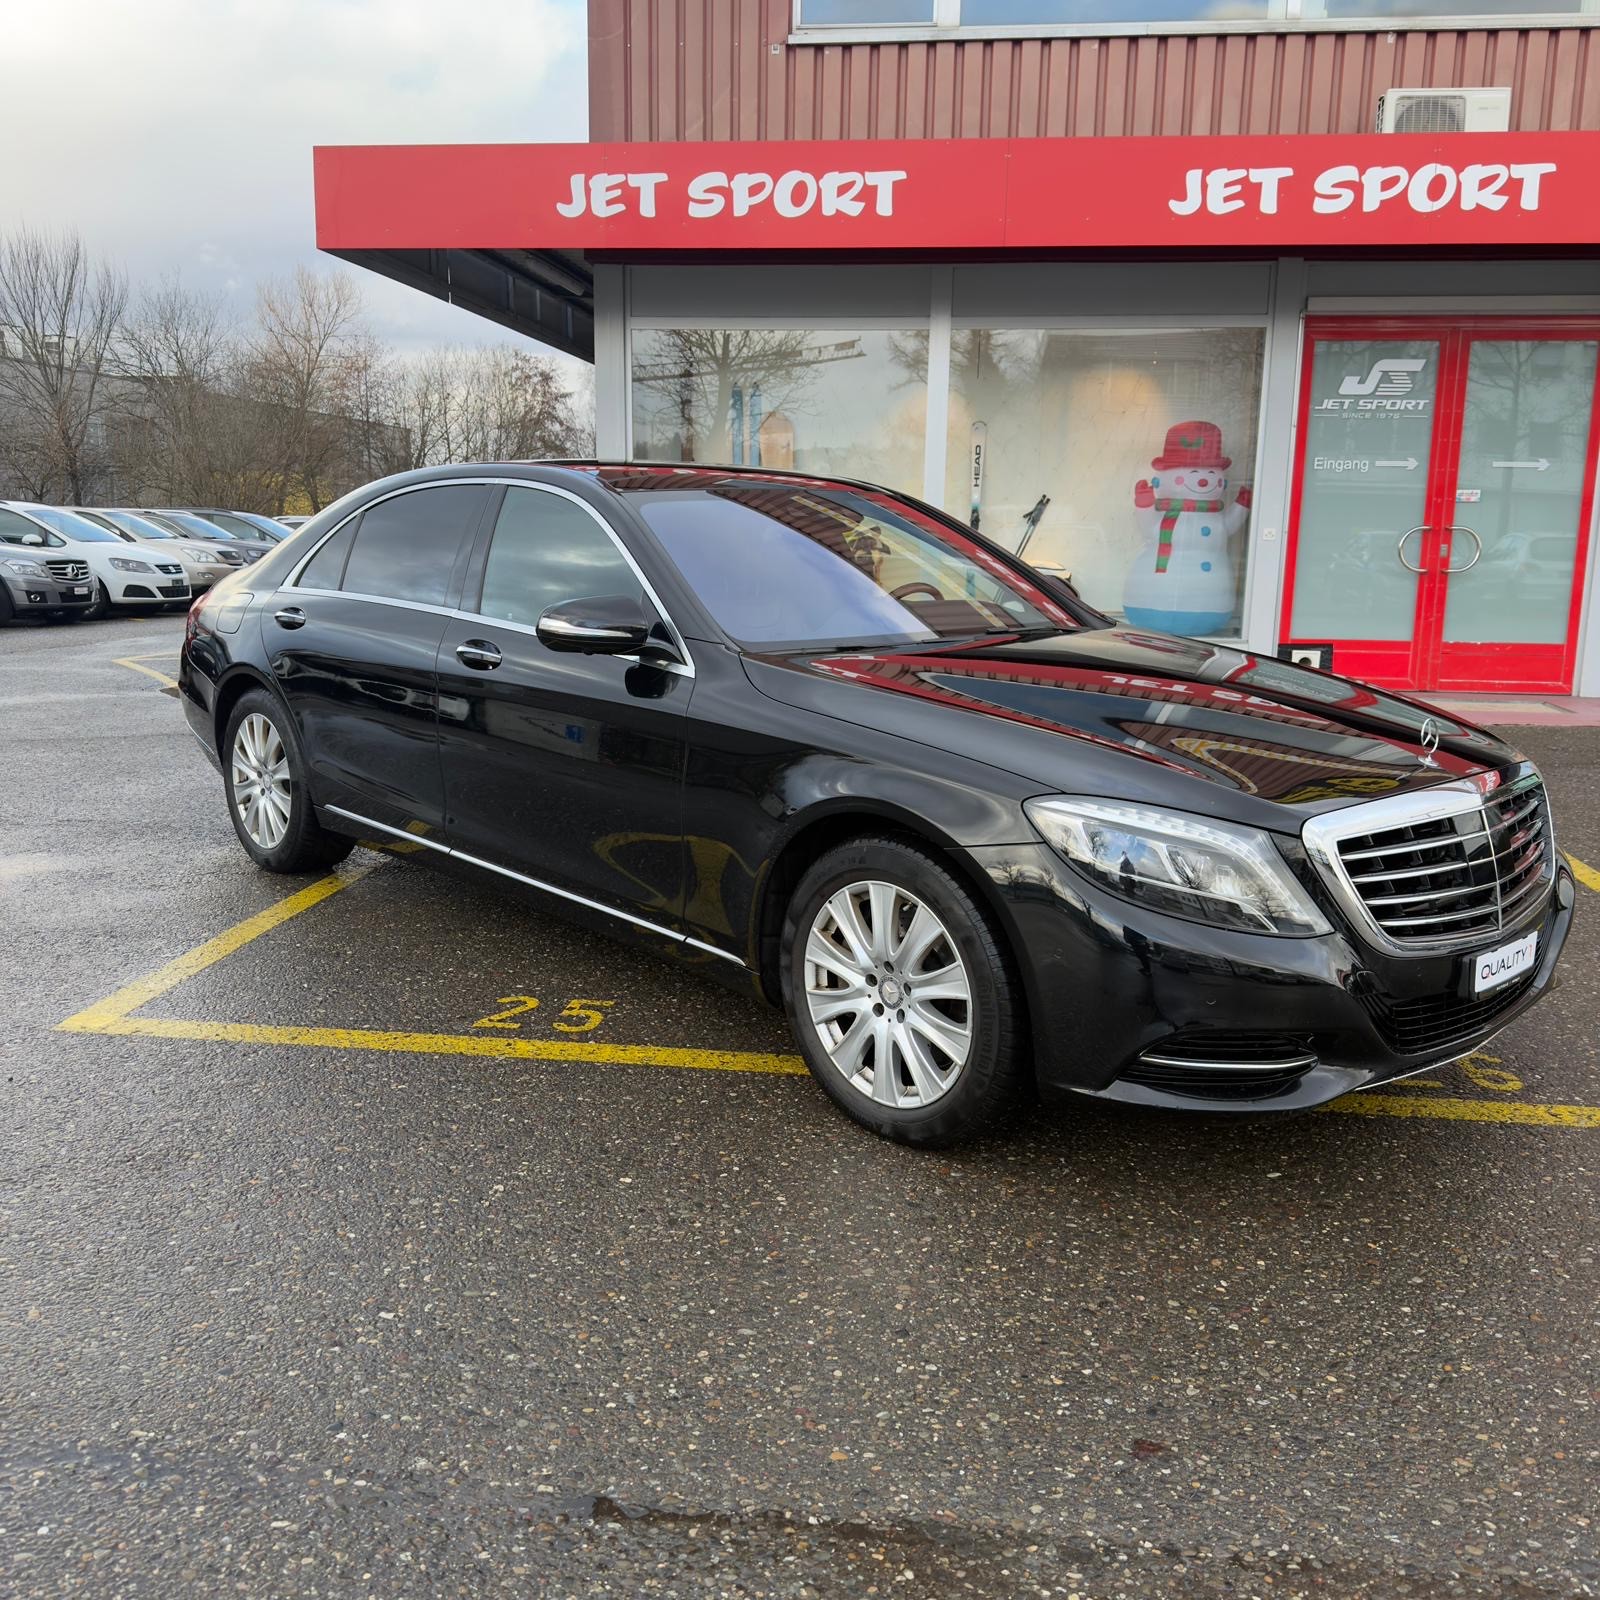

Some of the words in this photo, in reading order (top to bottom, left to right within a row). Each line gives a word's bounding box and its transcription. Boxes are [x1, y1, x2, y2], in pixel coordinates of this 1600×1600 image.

[556, 172, 669, 218] JET
[687, 169, 907, 218] SPORT
[1168, 167, 1294, 216] JET
[1312, 162, 1557, 215] SPORT
[1314, 399, 1355, 410] JET
[1357, 399, 1429, 410] SPORT
[973, 444, 982, 488] HEAD
[1313, 457, 1369, 473] Eingang
